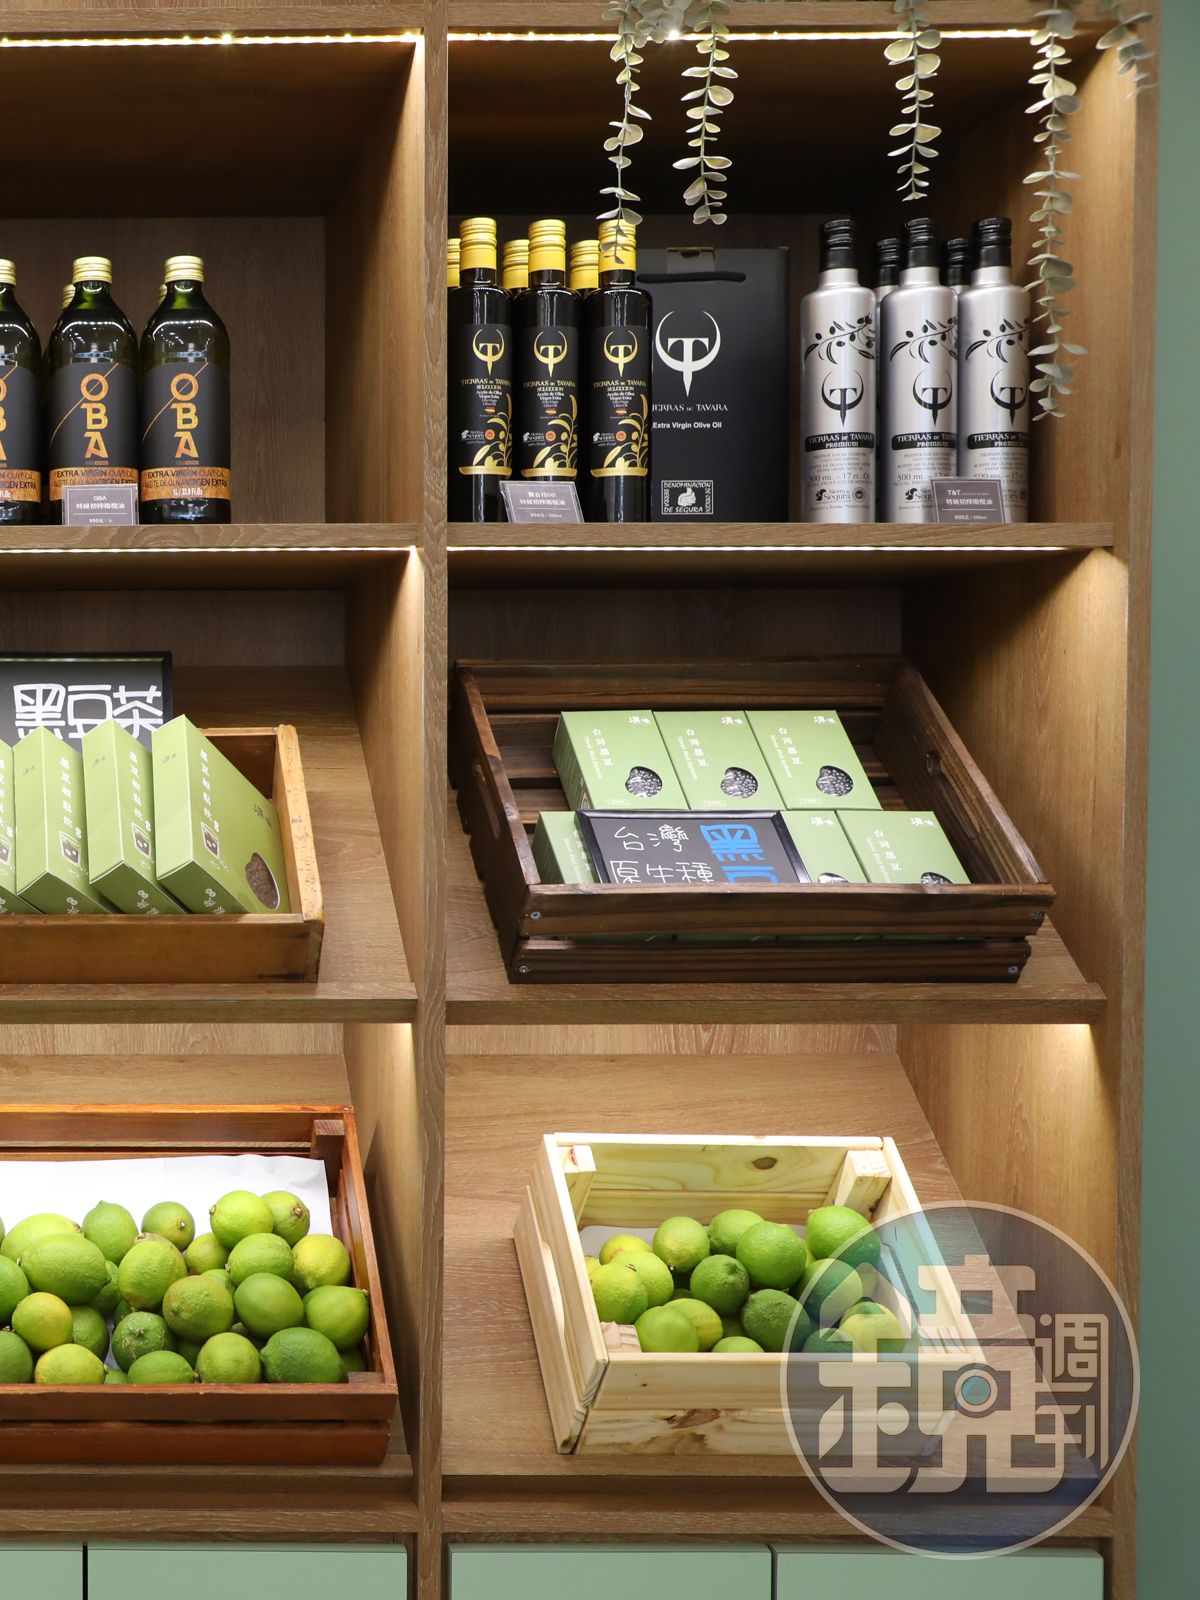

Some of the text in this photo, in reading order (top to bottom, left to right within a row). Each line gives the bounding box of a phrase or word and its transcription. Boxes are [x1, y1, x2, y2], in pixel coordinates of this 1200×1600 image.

[652, 404, 684, 412] IERRAS
[696, 404, 728, 412] TAVARA
[80, 373, 109, 459] OBA
[170, 373, 199, 459] OBA
[672, 422, 692, 430] Virgin
[712, 421, 722, 429] Oil
[897, 433, 932, 442] TIERRAS
[973, 433, 1010, 442] TIERRAS
[57, 470, 79, 478] EXTRA
[147, 470, 170, 478] EXTRA
[13, 683, 164, 740] 黑豆茶
[614, 824, 689, 852] 台灣
